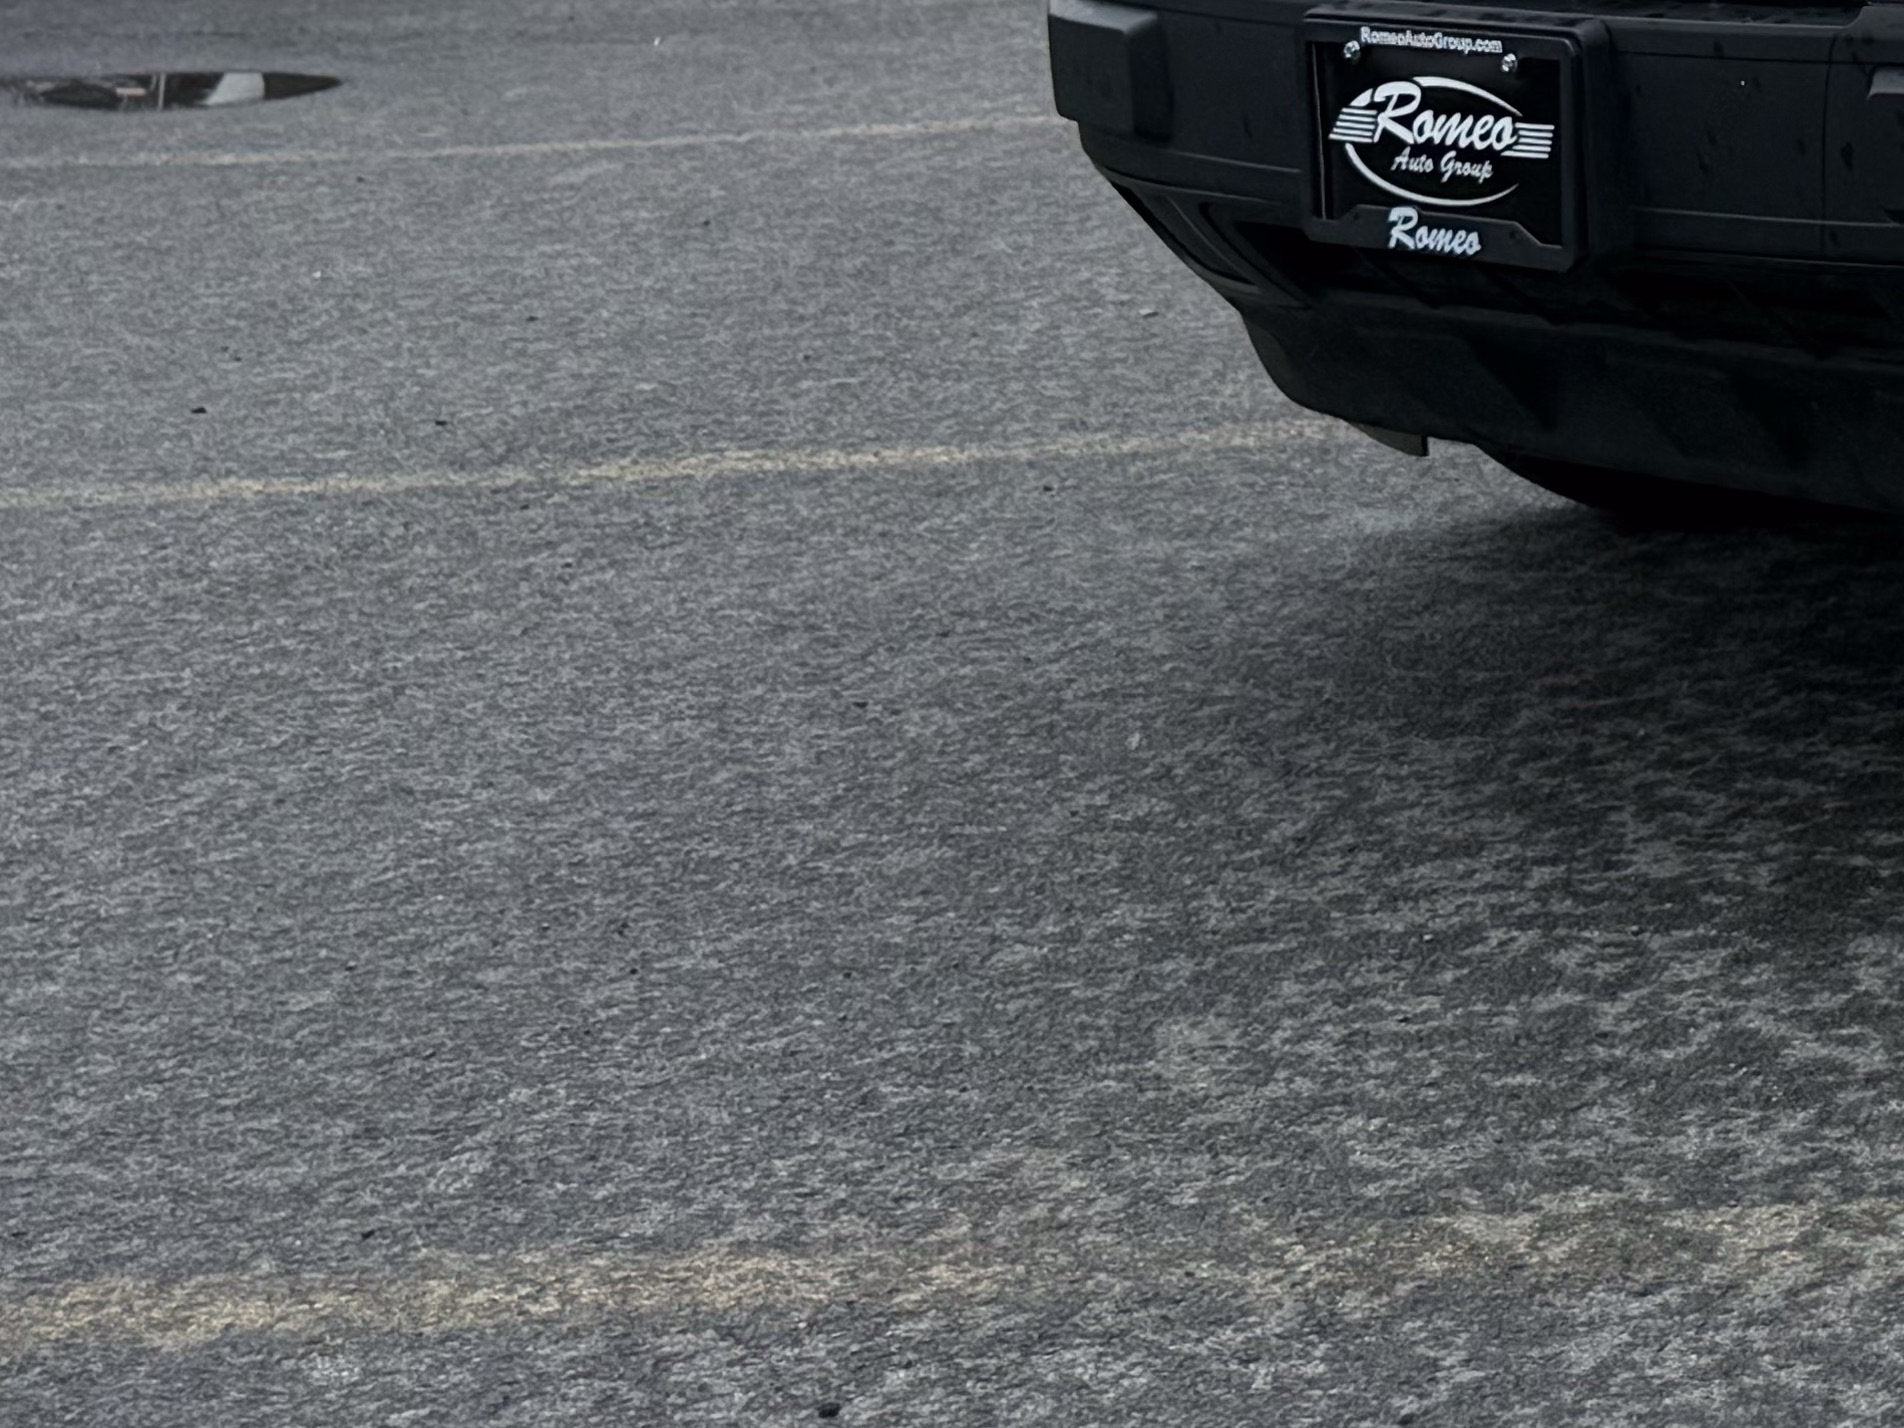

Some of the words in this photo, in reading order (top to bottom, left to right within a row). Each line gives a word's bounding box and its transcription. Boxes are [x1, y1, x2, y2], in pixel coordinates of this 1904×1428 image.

[1360, 25, 1503, 55] RomeoAutoGroup.com
[1372, 80, 1519, 149] Romeo
[1391, 146, 1434, 173] Auto
[1440, 149, 1494, 184] Group
[1387, 206, 1482, 256] Romeo
